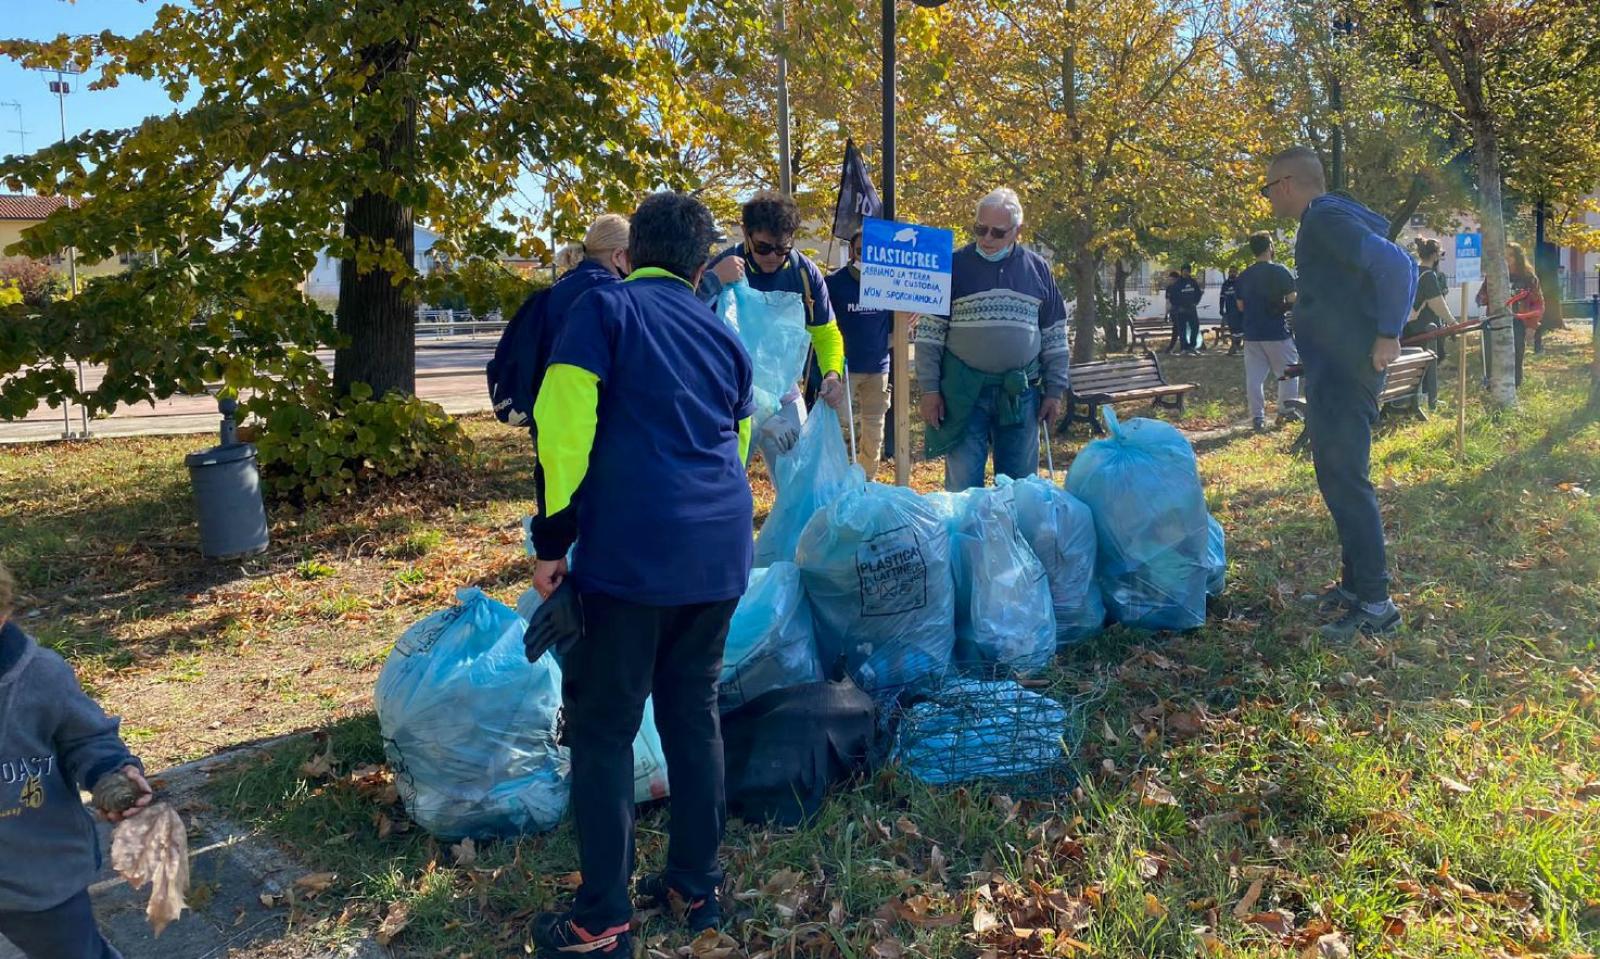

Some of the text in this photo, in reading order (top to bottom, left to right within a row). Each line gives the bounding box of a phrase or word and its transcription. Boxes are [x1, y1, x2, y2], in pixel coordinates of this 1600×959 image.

[866, 245, 939, 269] PLASTICFREE
[862, 266, 931, 281] ABBIAMO LA TERRA
[893, 278, 901, 287] IN
[863, 286, 882, 298] NON
[860, 546, 919, 574] PLASTICA
[873, 562, 912, 582] LATTINE
[18, 773, 44, 808] 45
